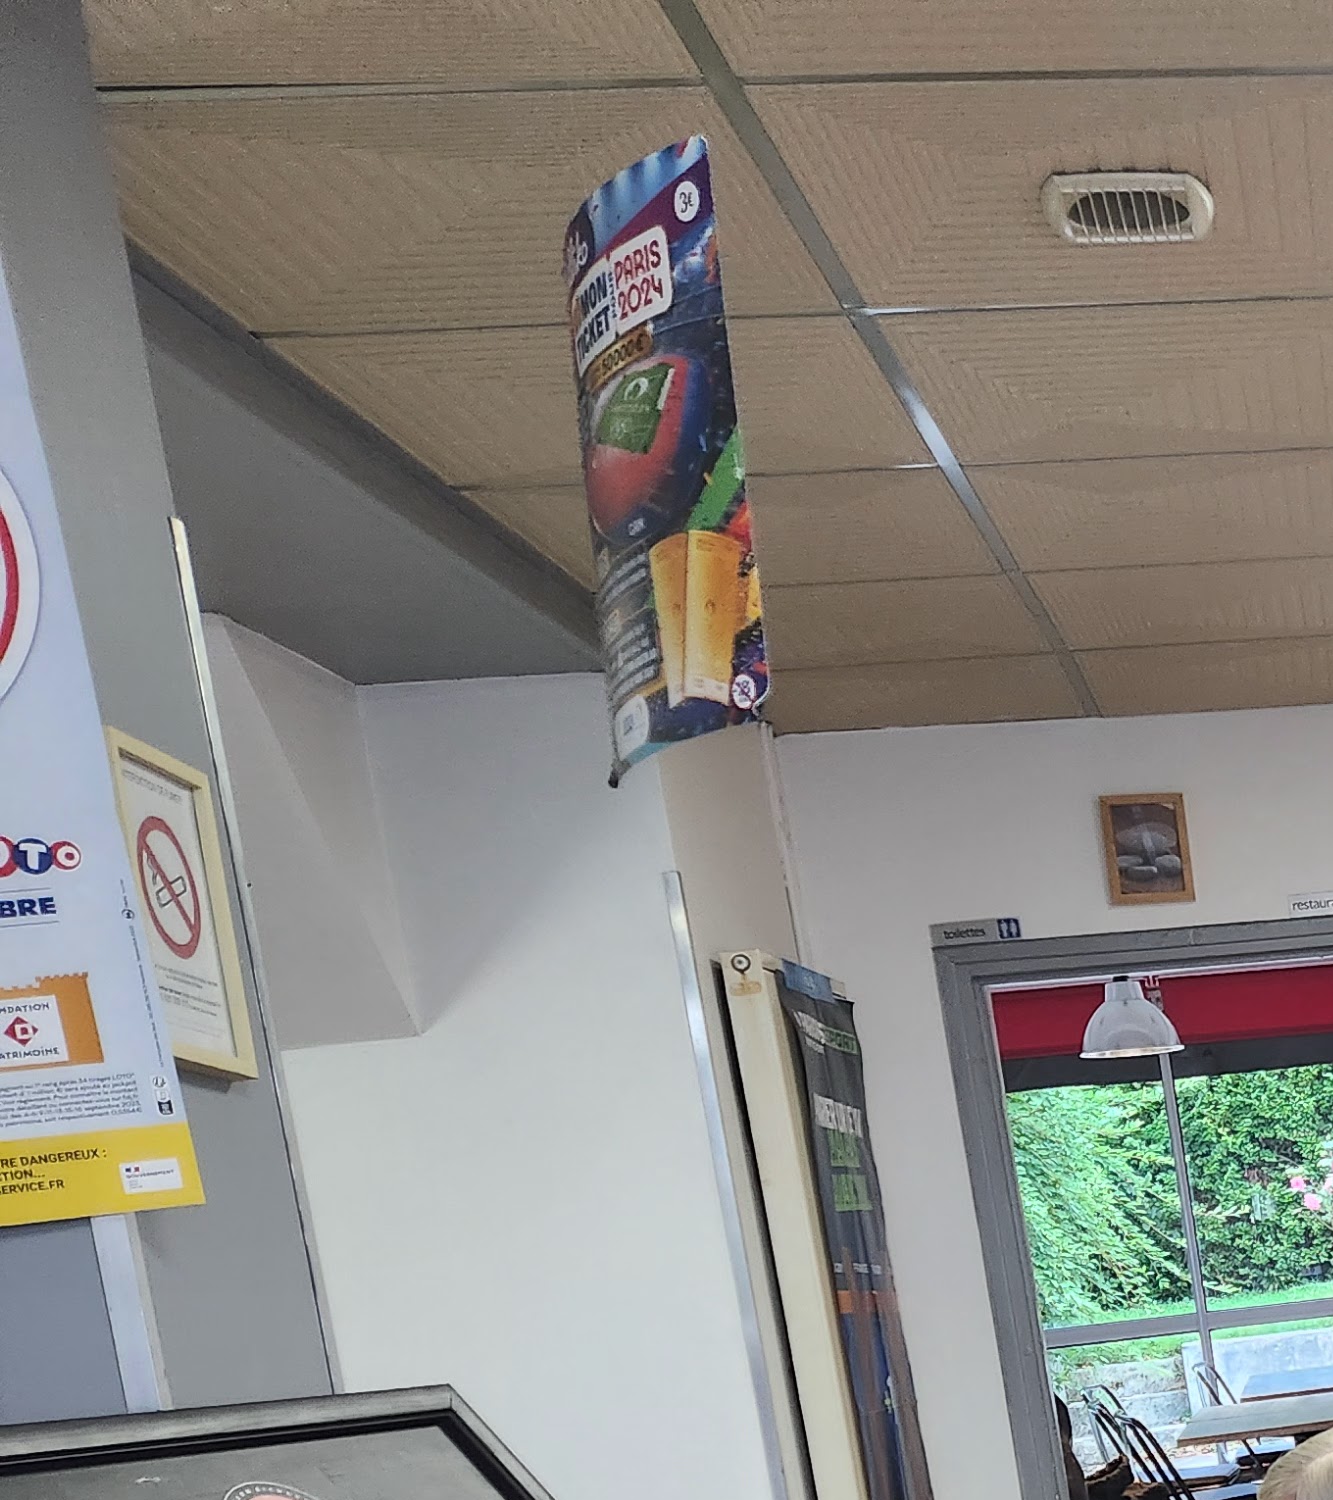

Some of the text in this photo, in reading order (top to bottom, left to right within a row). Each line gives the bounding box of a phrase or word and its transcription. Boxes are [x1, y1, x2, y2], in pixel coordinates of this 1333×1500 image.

[613, 239, 663, 290] PARIS
[577, 271, 608, 318] MON
[616, 275, 665, 322] 2024
[942, 927, 987, 940] toilettes
[19, 1148, 101, 1167] DANGEREUX
